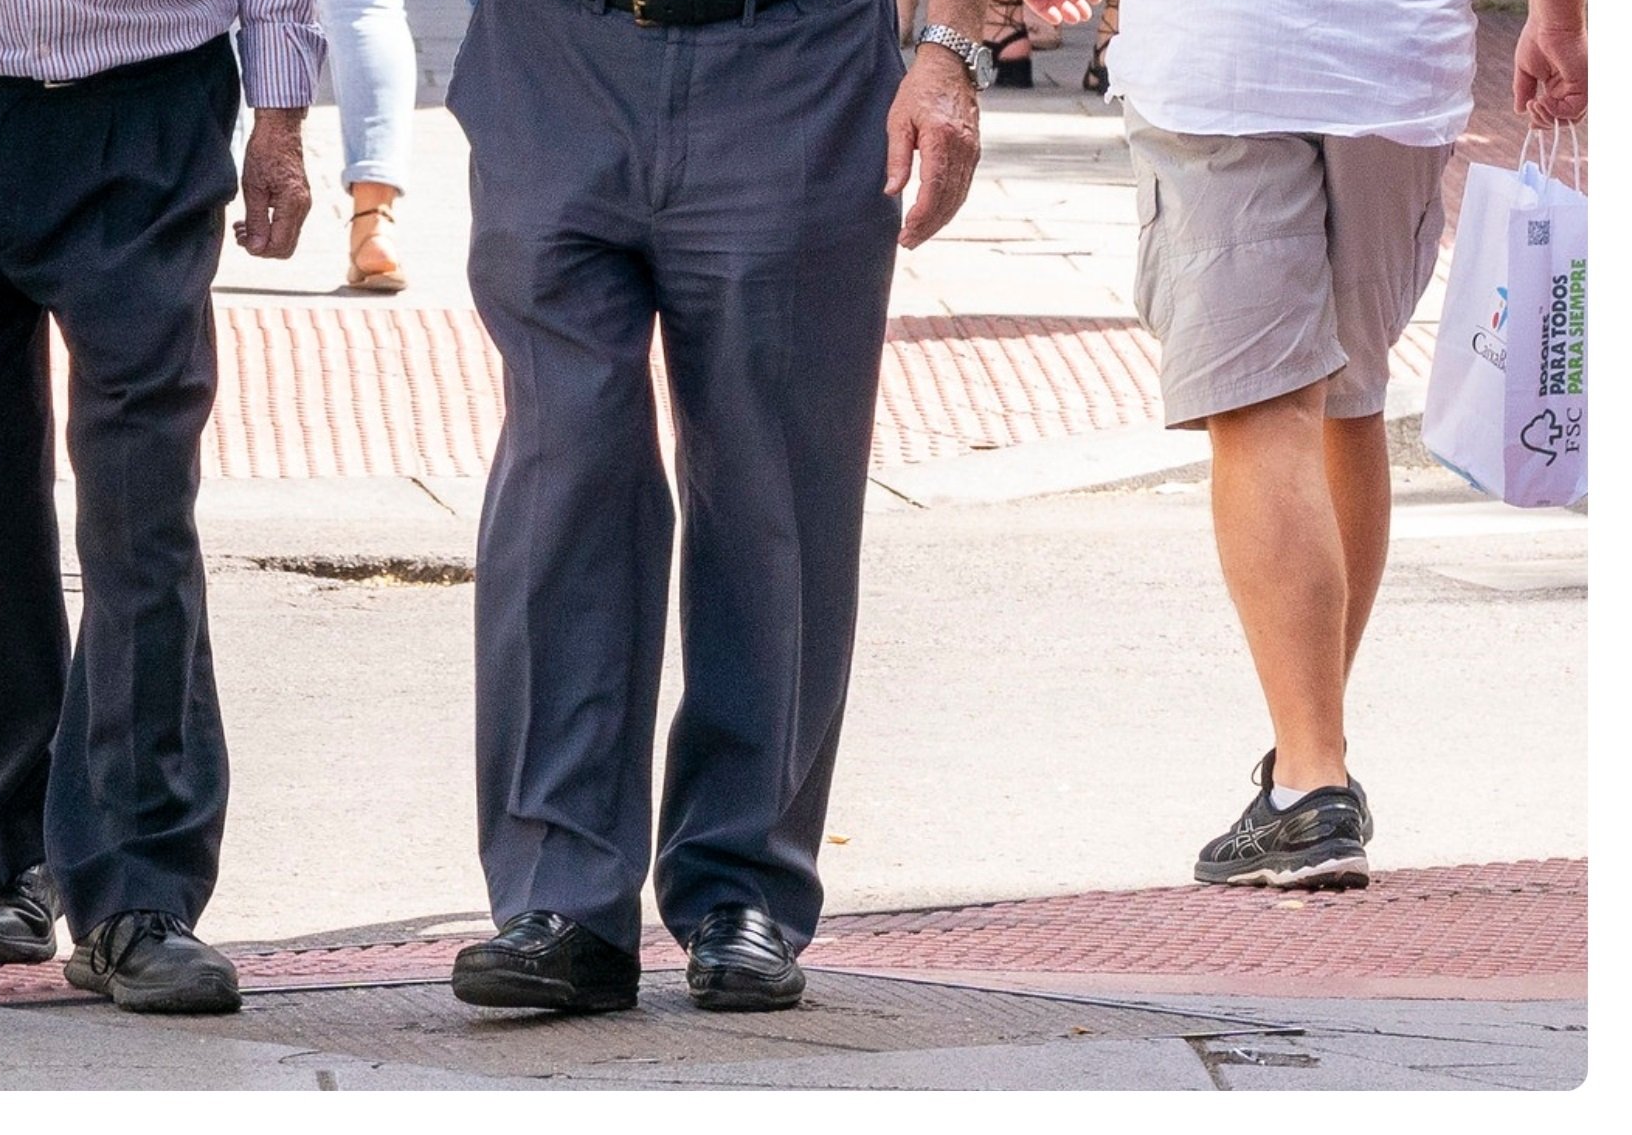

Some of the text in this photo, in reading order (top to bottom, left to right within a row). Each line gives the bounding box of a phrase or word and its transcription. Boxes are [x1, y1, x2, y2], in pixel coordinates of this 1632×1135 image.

[1550, 275, 1568, 394] PARA TODOS
[1568, 259, 1586, 394] PARA SIEMPRE
[1565, 407, 1582, 453] FSC
